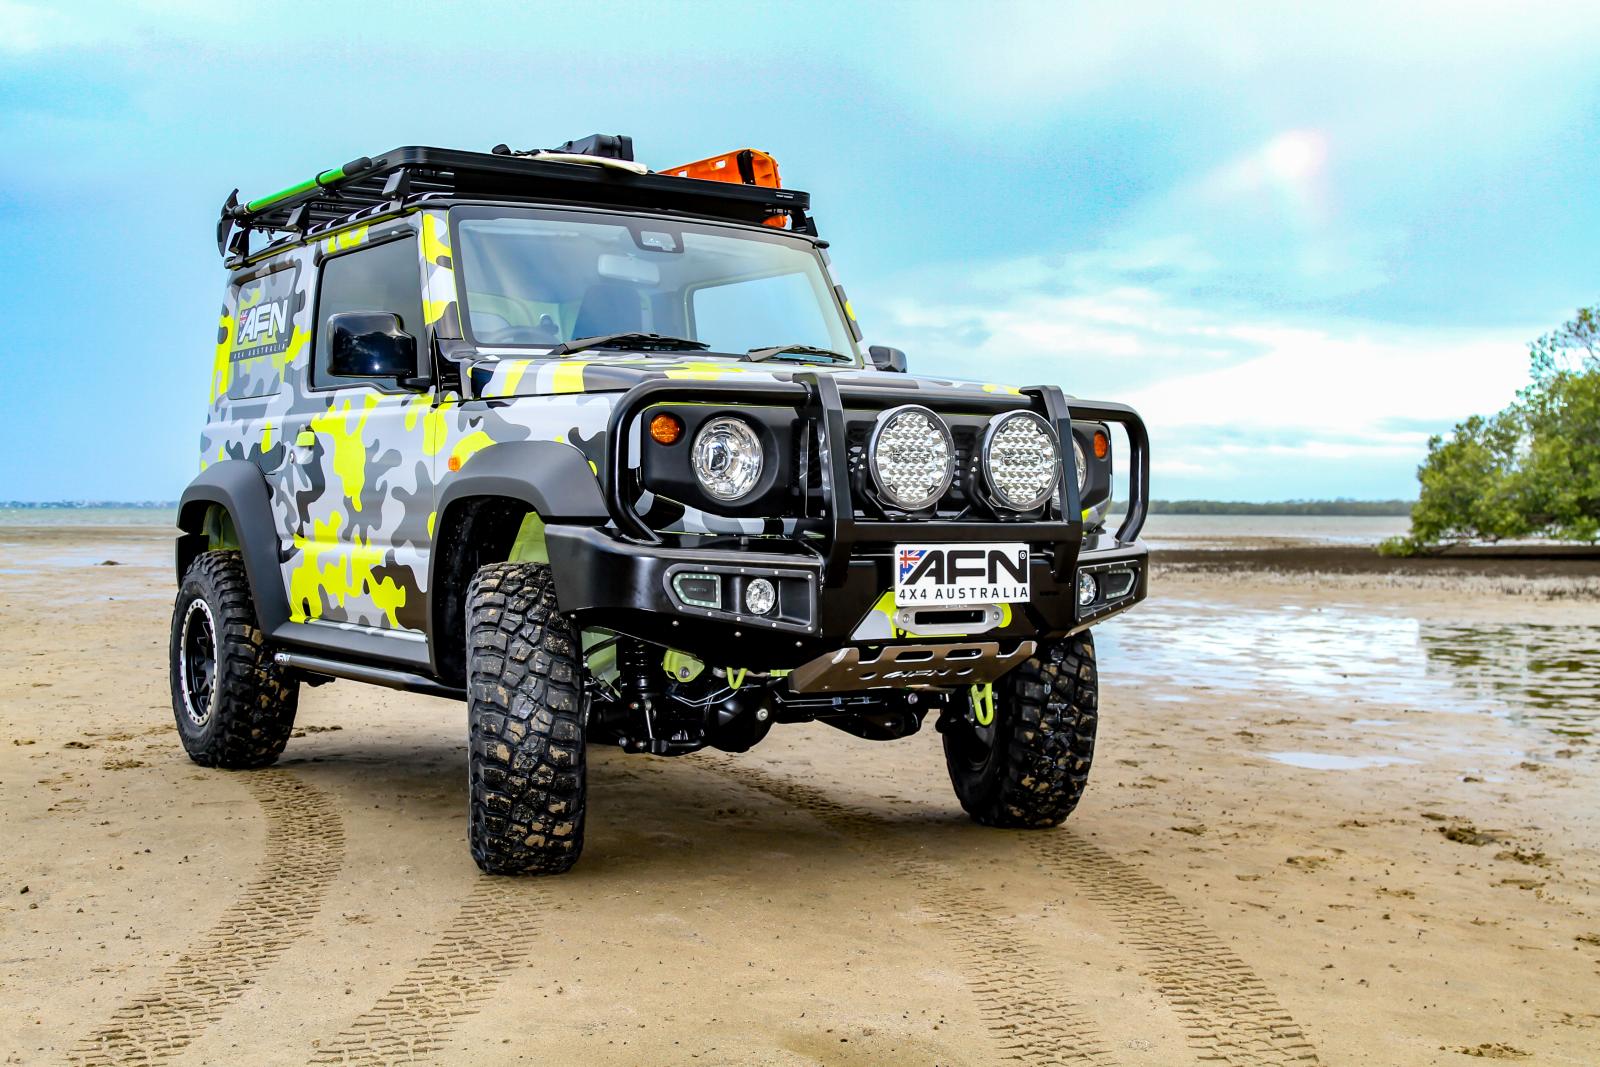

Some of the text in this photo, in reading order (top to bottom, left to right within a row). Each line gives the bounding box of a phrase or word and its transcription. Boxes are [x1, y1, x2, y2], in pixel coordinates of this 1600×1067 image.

[238, 299, 289, 343] AFN
[903, 550, 1028, 585] AFN
[899, 586, 1028, 600] 4X4 AUSTRALIA
